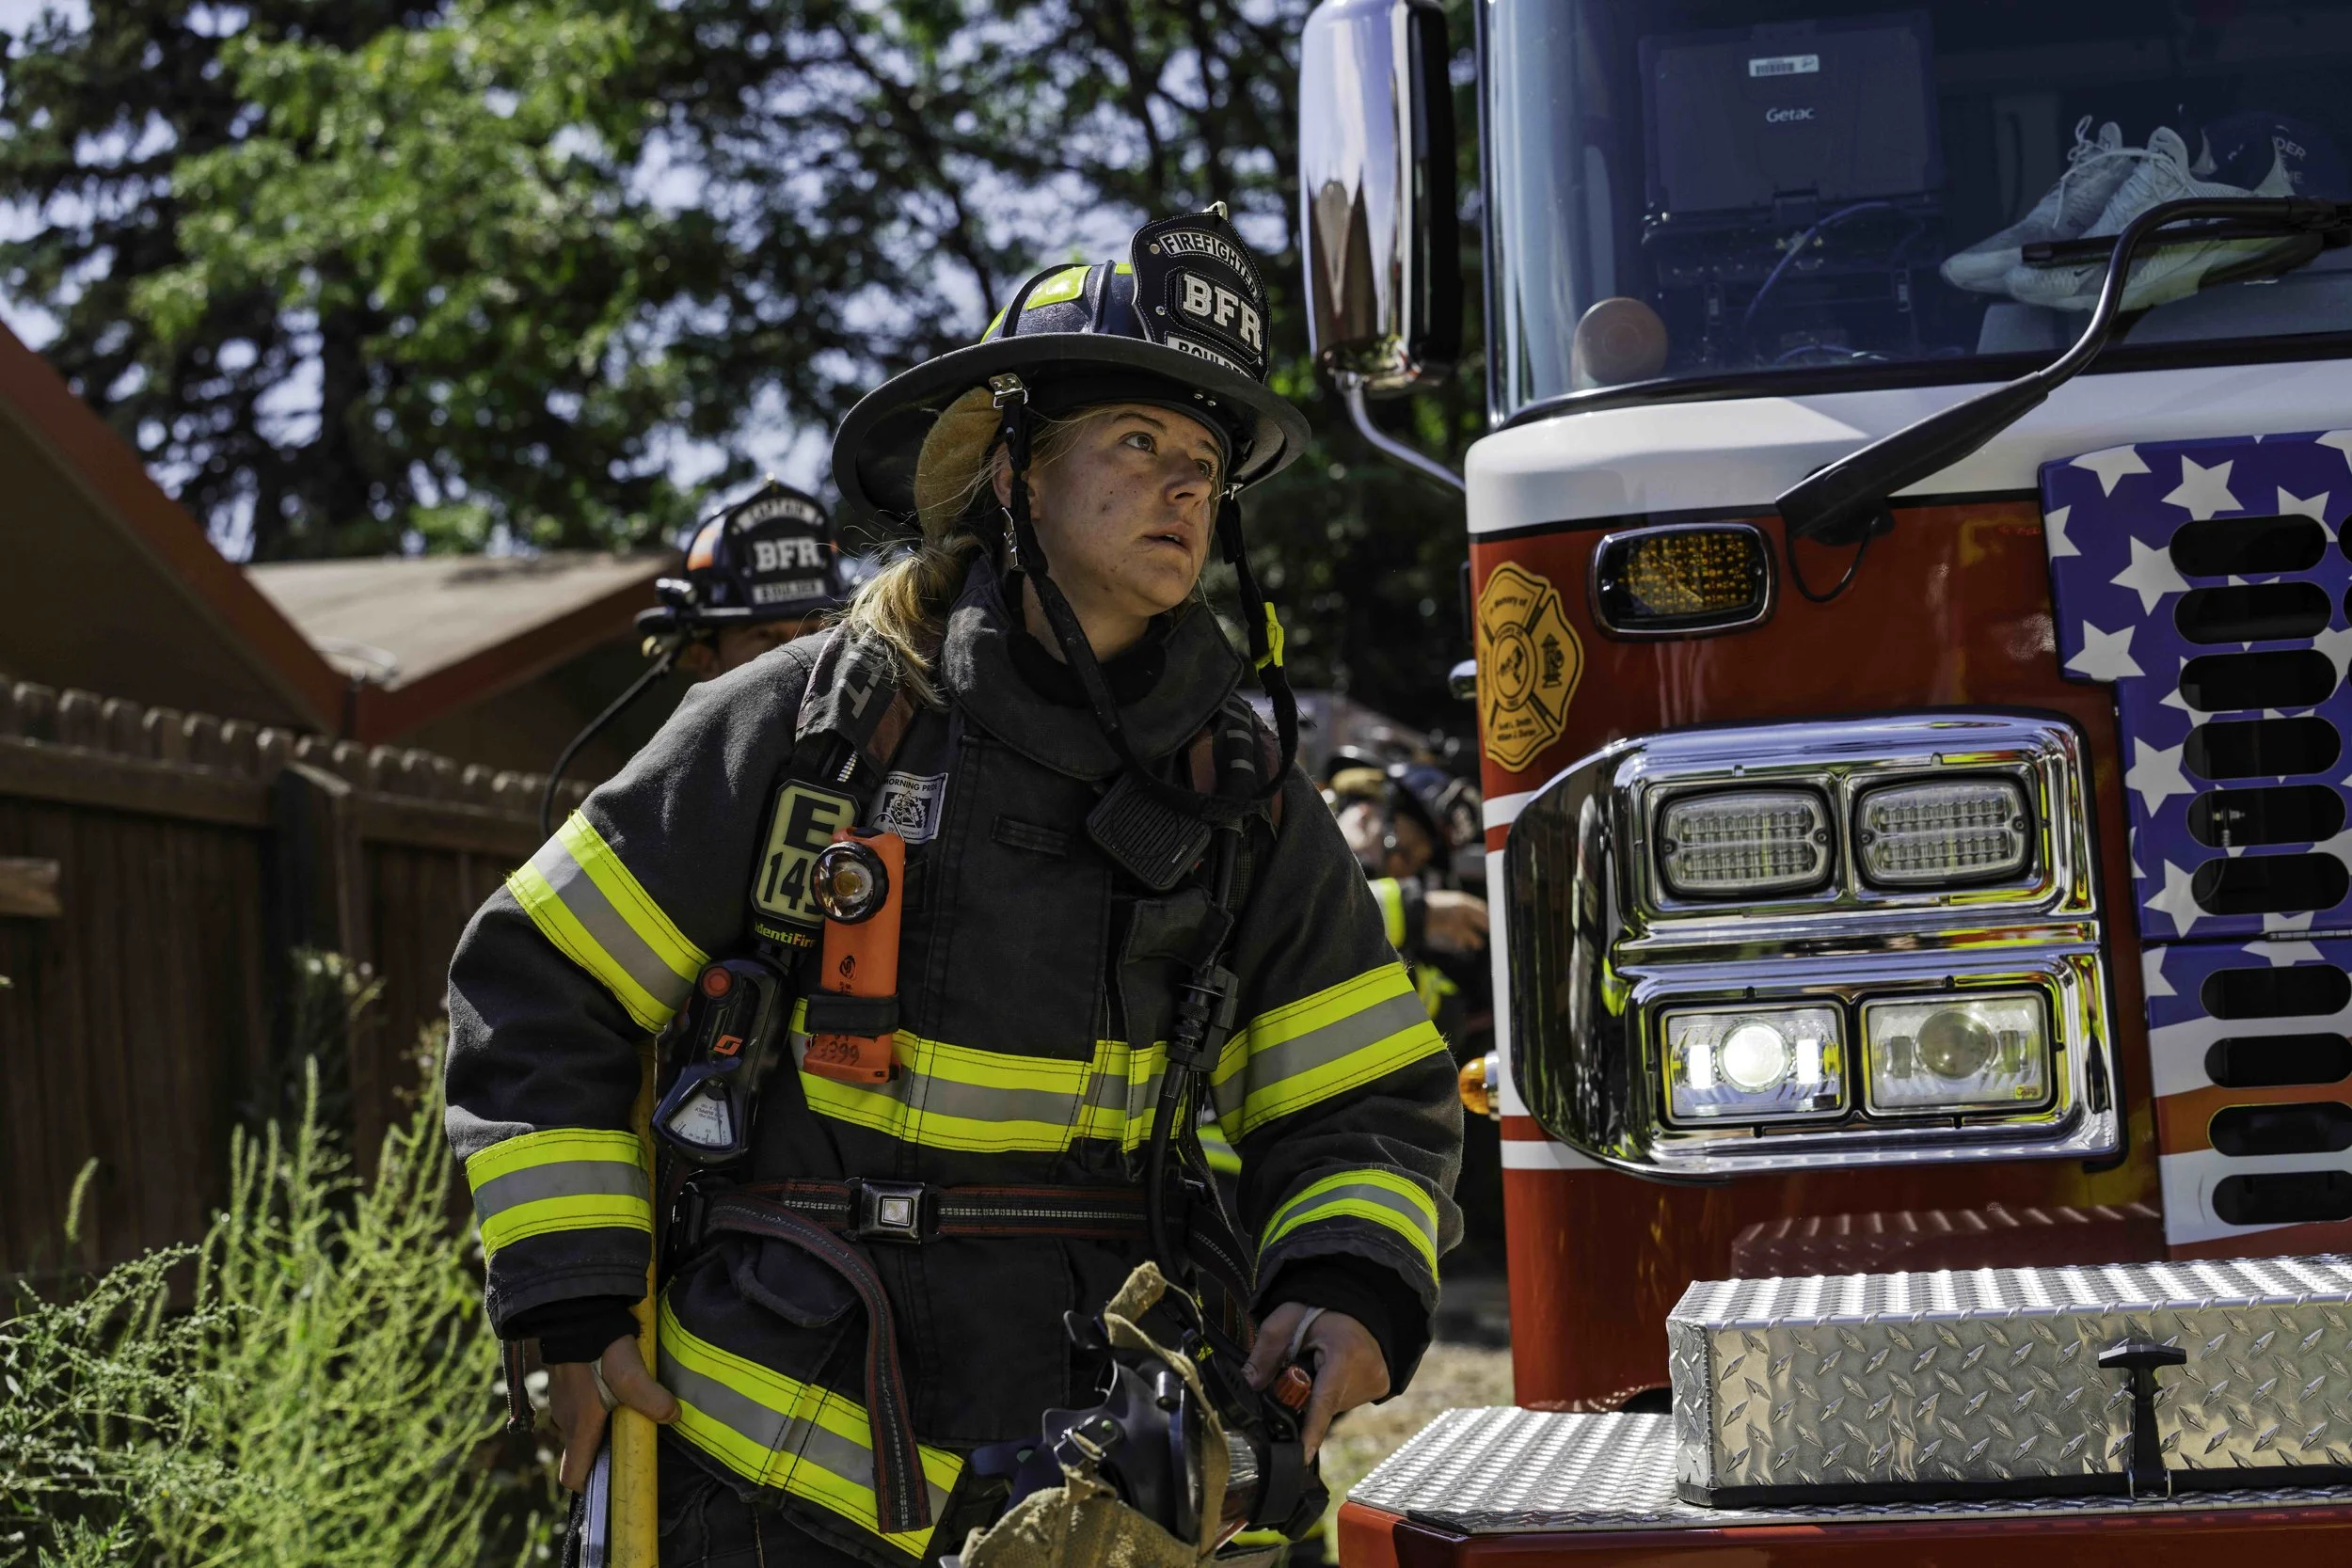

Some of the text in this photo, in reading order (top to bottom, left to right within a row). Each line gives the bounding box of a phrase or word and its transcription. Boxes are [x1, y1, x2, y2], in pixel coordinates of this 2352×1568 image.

[1766, 107, 1815, 122] Getac
[1163, 232, 1258, 295] FIREFIGHTER
[1183, 274, 1262, 352] BFR
[754, 536, 821, 572] BFR
[922, 783, 938, 792] PRIDE
[784, 794, 841, 853] E
